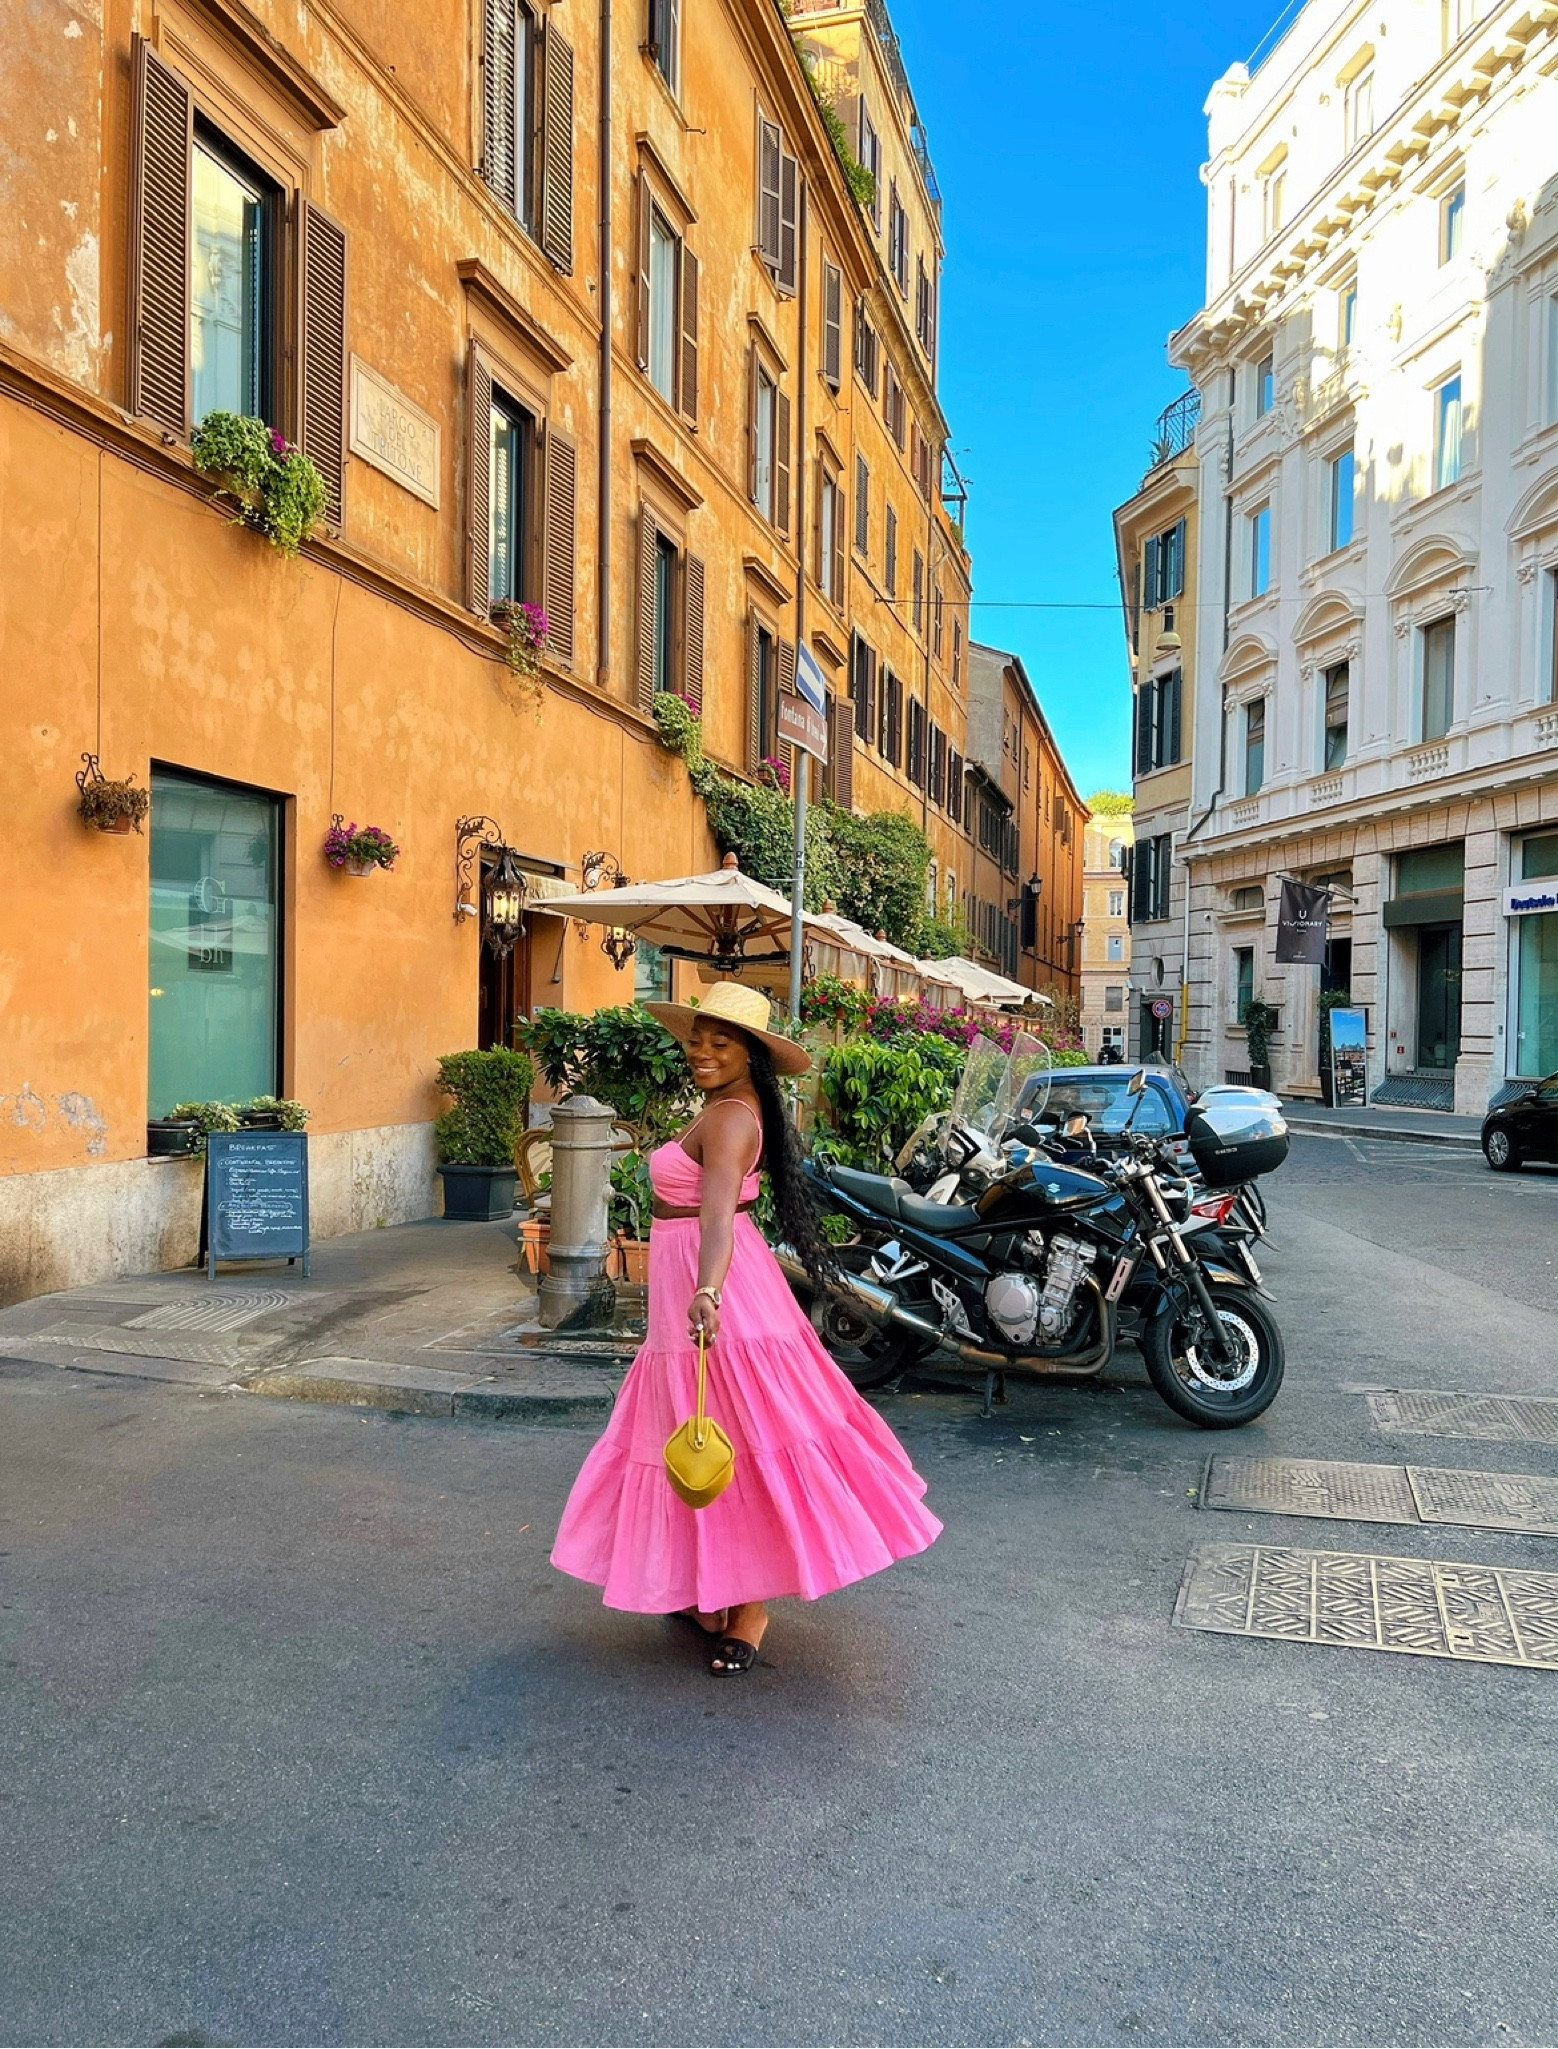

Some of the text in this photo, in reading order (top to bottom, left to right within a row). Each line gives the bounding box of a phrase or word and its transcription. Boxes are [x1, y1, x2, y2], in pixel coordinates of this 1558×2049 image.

[380, 399, 416, 439] LARGO
[372, 431, 423, 482] TRITONE
[389, 427, 406, 451] DEL
[194, 876, 226, 914] G
